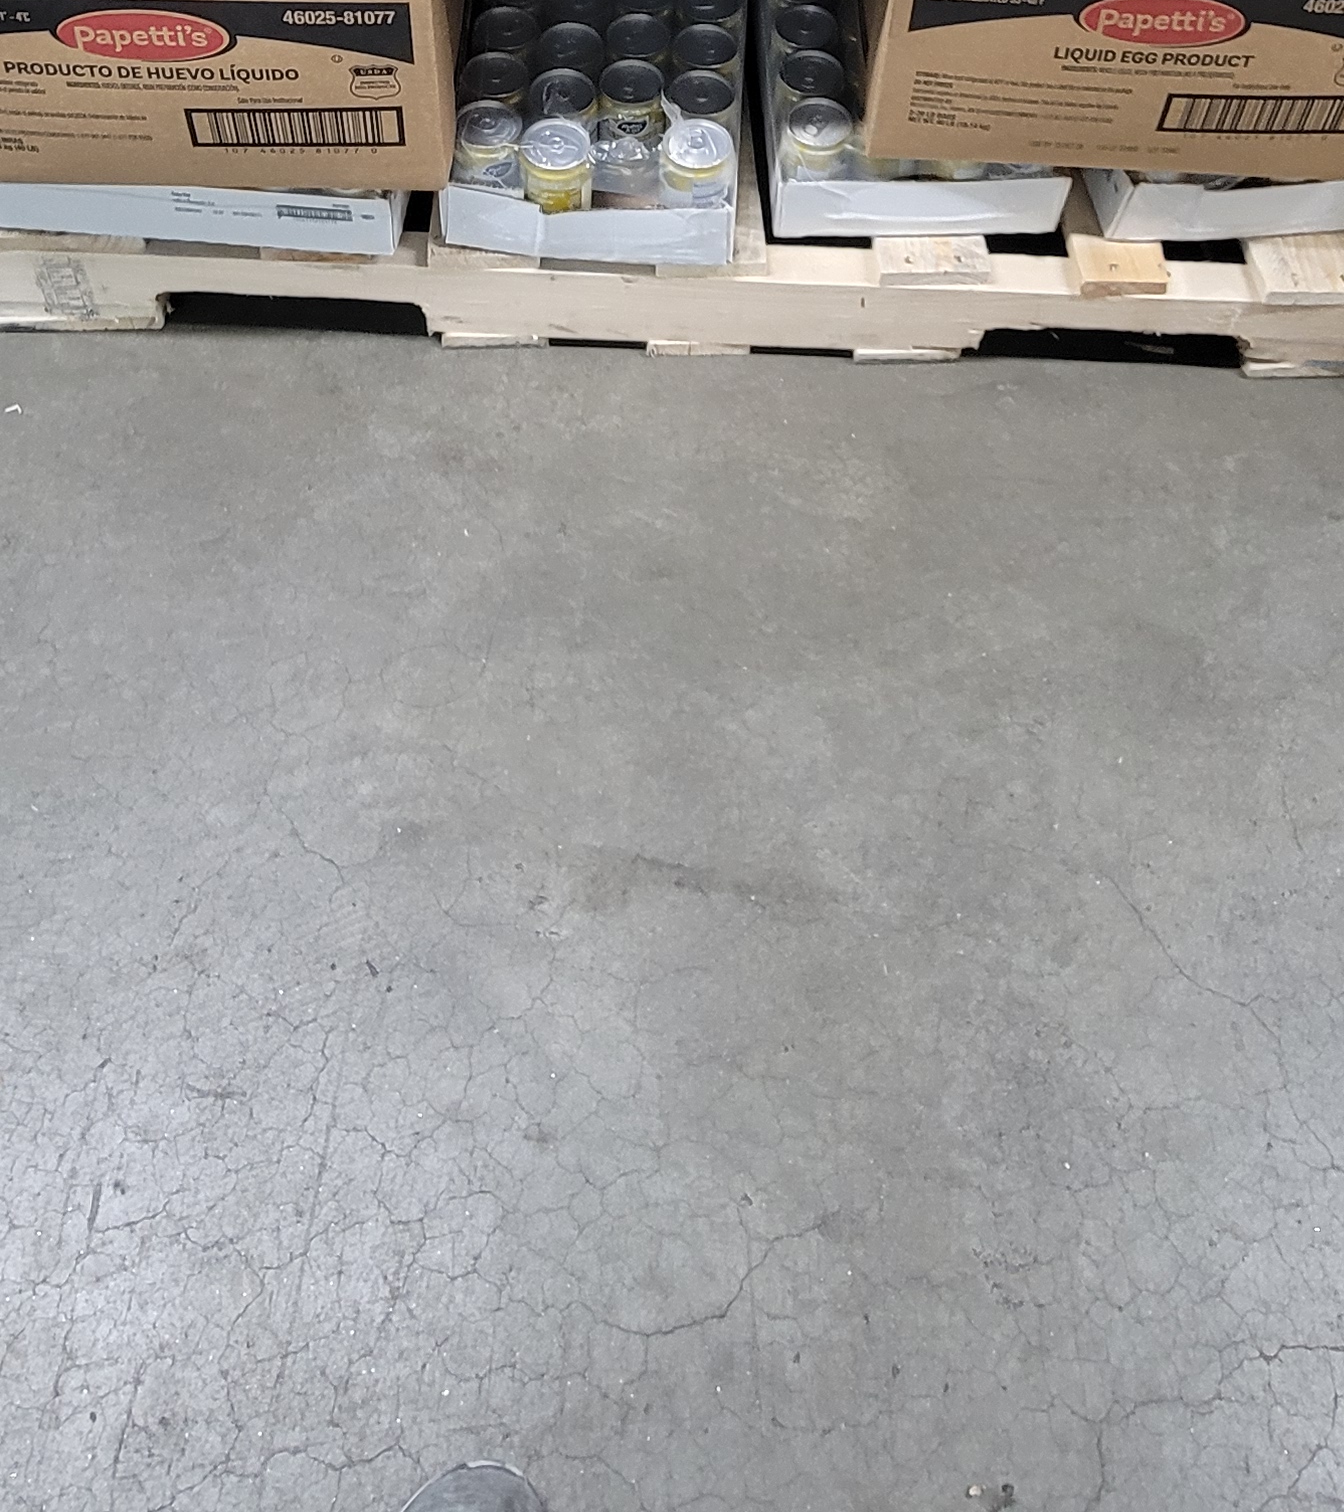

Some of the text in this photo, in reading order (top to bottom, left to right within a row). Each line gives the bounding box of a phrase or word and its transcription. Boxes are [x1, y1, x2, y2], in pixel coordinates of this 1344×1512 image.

[282, 9, 396, 26] 46025-81077
[1097, 8, 1227, 37] Papetti's
[73, 21, 209, 53] Papetti's
[1053, 46, 1254, 69] LIQUID EGG PRODUCT
[3, 61, 300, 84] PRODUCTO DE HUEVO LÍQUIDO
